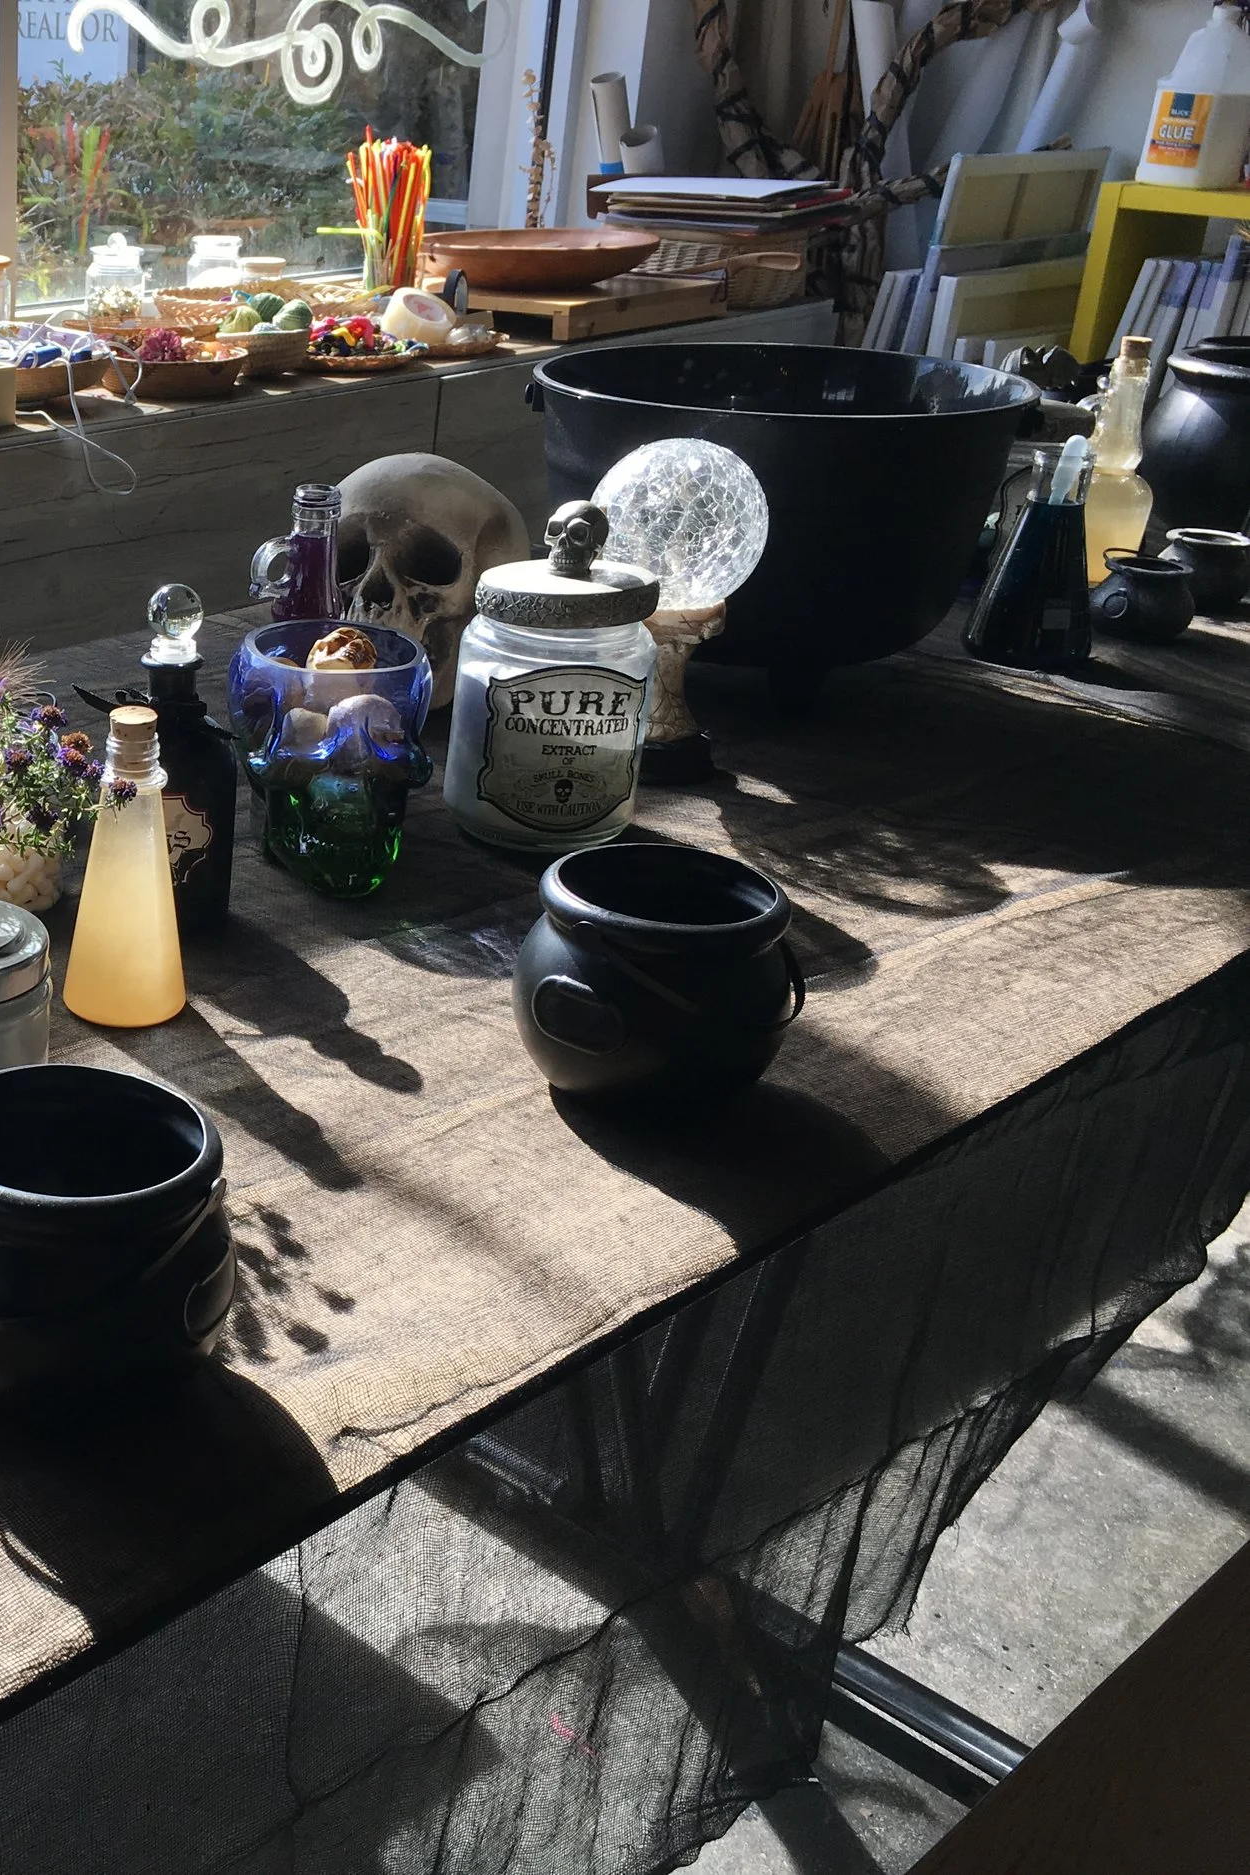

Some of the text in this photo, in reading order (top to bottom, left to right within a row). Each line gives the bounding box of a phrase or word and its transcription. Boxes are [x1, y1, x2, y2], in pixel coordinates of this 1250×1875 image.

[1159, 124, 1194, 140] GLUE
[508, 690, 631, 717] PURE
[505, 717, 628, 736] CONCENTRATED
[541, 745, 597, 755] EXTRACT
[561, 757, 575, 765] OF
[533, 770, 596, 782] SKULL BONES
[516, 800, 602, 816] USE WITH CAUTION
